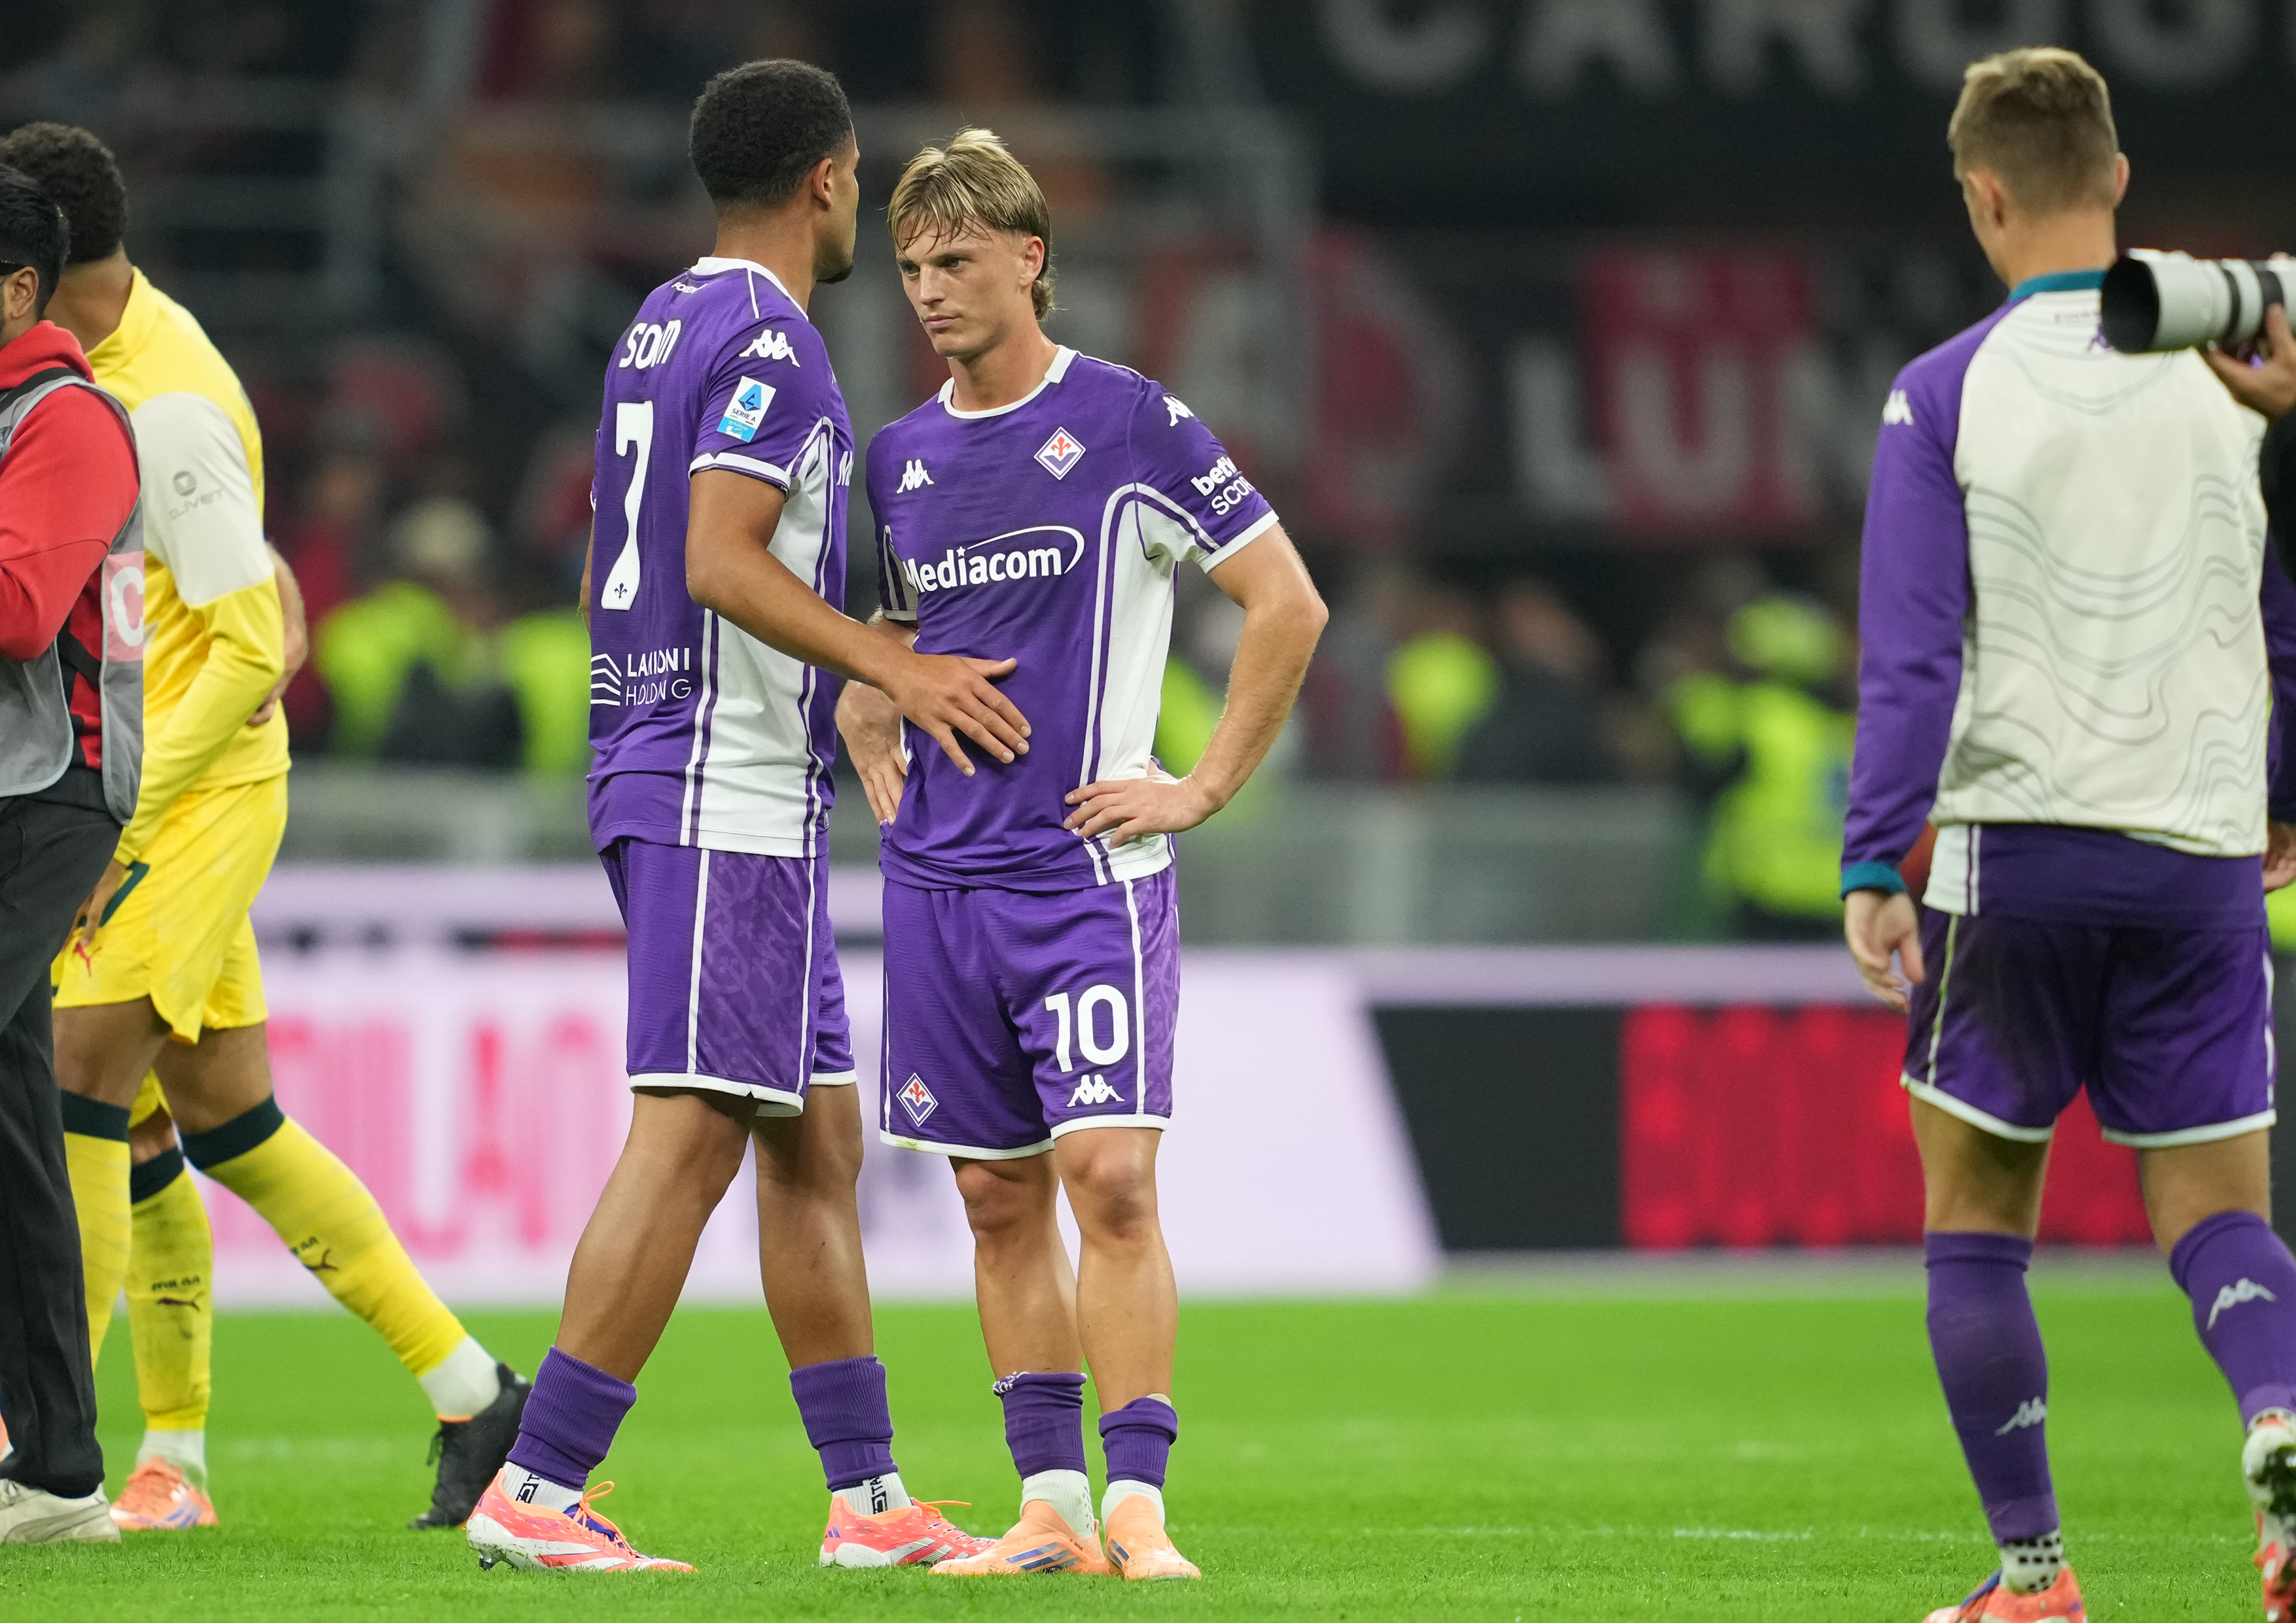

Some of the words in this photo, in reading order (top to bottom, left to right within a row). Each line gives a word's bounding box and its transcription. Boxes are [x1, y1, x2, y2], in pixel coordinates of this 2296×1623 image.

[728, 419, 749, 431] enilive
[731, 408, 751, 419] SERIE
[601, 401, 653, 610] 7
[903, 546, 1062, 594] Mediacom
[1045, 984, 1129, 1073] 10
